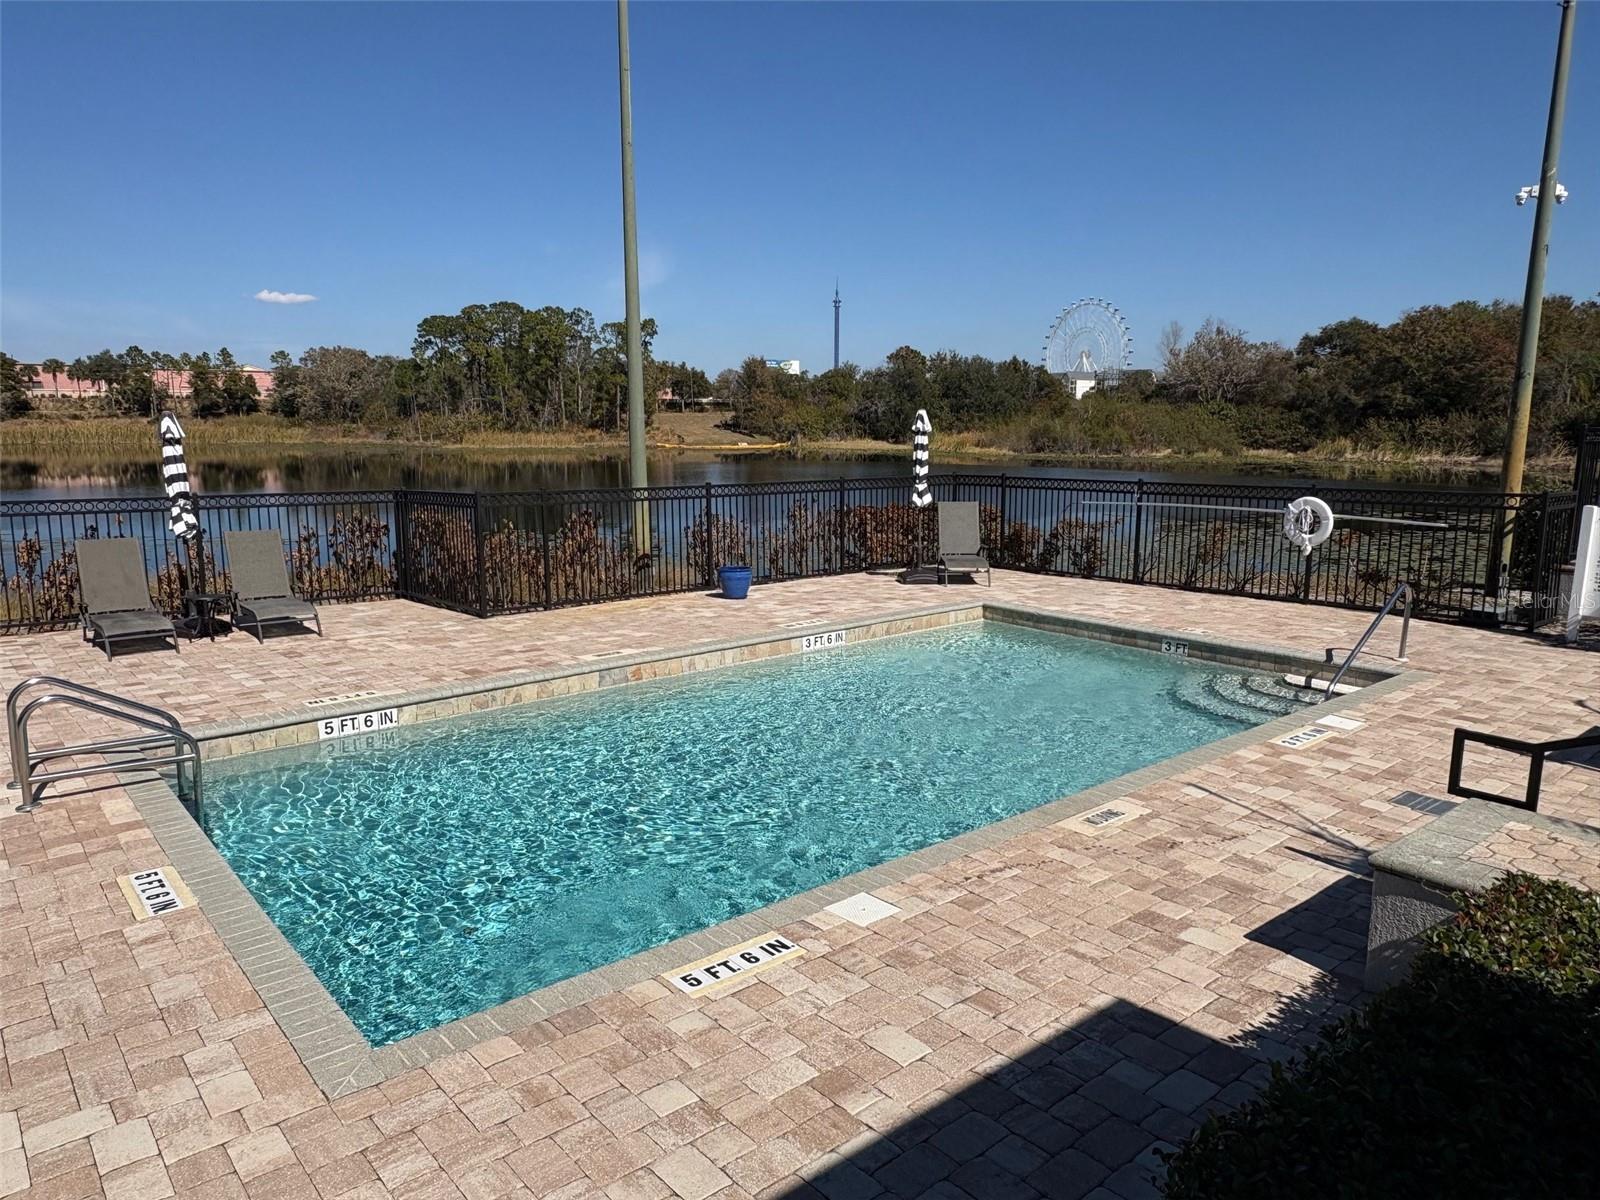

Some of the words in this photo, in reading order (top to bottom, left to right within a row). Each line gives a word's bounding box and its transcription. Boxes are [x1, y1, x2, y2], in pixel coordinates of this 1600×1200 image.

[805, 638, 811, 648] 3
[827, 634, 833, 644] 6
[1164, 640, 1172, 652] 3
[324, 721, 334, 735] 5
[340, 716, 359, 733] FT.
[364, 714, 374, 728] 6
[380, 710, 398, 726] IN.
[134, 871, 159, 880] 5
[145, 891, 171, 901] 6
[679, 973, 703, 987] 5
[703, 960, 742, 980] FT.
[739, 951, 761, 964] 6
[758, 939, 796, 957] IN.
